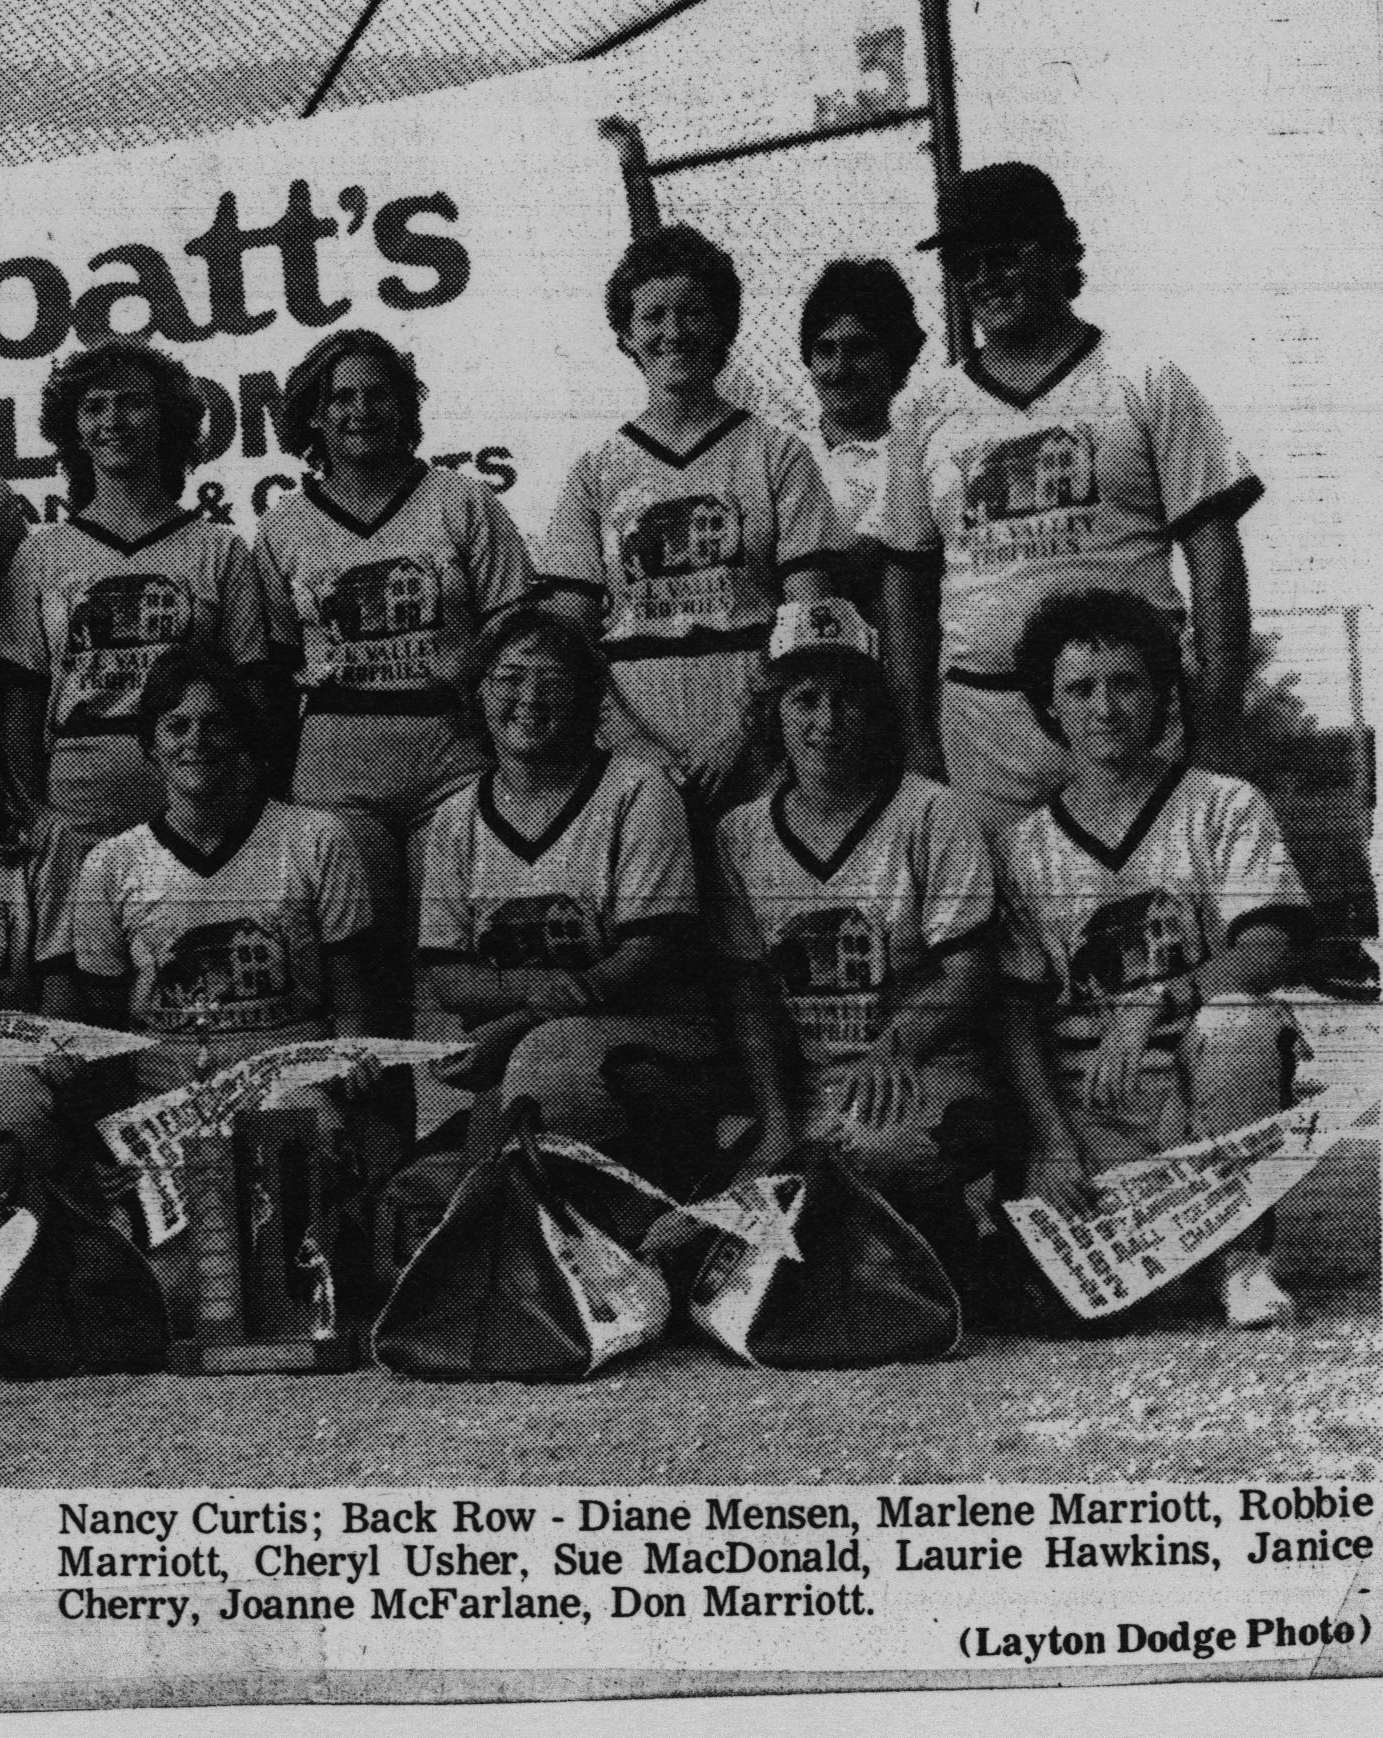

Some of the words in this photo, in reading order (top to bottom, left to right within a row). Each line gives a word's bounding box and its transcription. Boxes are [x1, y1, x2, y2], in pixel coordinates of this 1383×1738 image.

[59, 1503, 178, 1542] Nancy
[192, 1502, 322, 1541] Curtis;
[342, 1500, 437, 1534] Back
[453, 1500, 536, 1533] Row
[579, 1499, 691, 1532] Diane
[705, 1498, 859, 1536] Mensen,
[877, 1494, 1034, 1528] Marlene
[1049, 1490, 1222, 1528] Marriott,
[1239, 1485, 1374, 1521] Robbie
[58, 1545, 228, 1584] Marriott,
[255, 1544, 379, 1585] Cheryl
[404, 1543, 528, 1578] Usher,
[554, 1542, 622, 1576] Sue
[644, 1538, 870, 1579] MacDonald,
[896, 1537, 1022, 1571] Laurie
[1045, 1533, 1220, 1571] Hawkins,
[1247, 1529, 1374, 1564] Janice
[58, 1587, 200, 1628] Cherry,
[219, 1588, 355, 1620] Joanne
[371, 1586, 591, 1625] McFarlane,
[611, 1586, 686, 1618] Don
[703, 1584, 874, 1617] Marriott.
[959, 1626, 1106, 1664] (Layton
[1117, 1621, 1236, 1660] Dodge
[1246, 1614, 1371, 1648] Photo)
